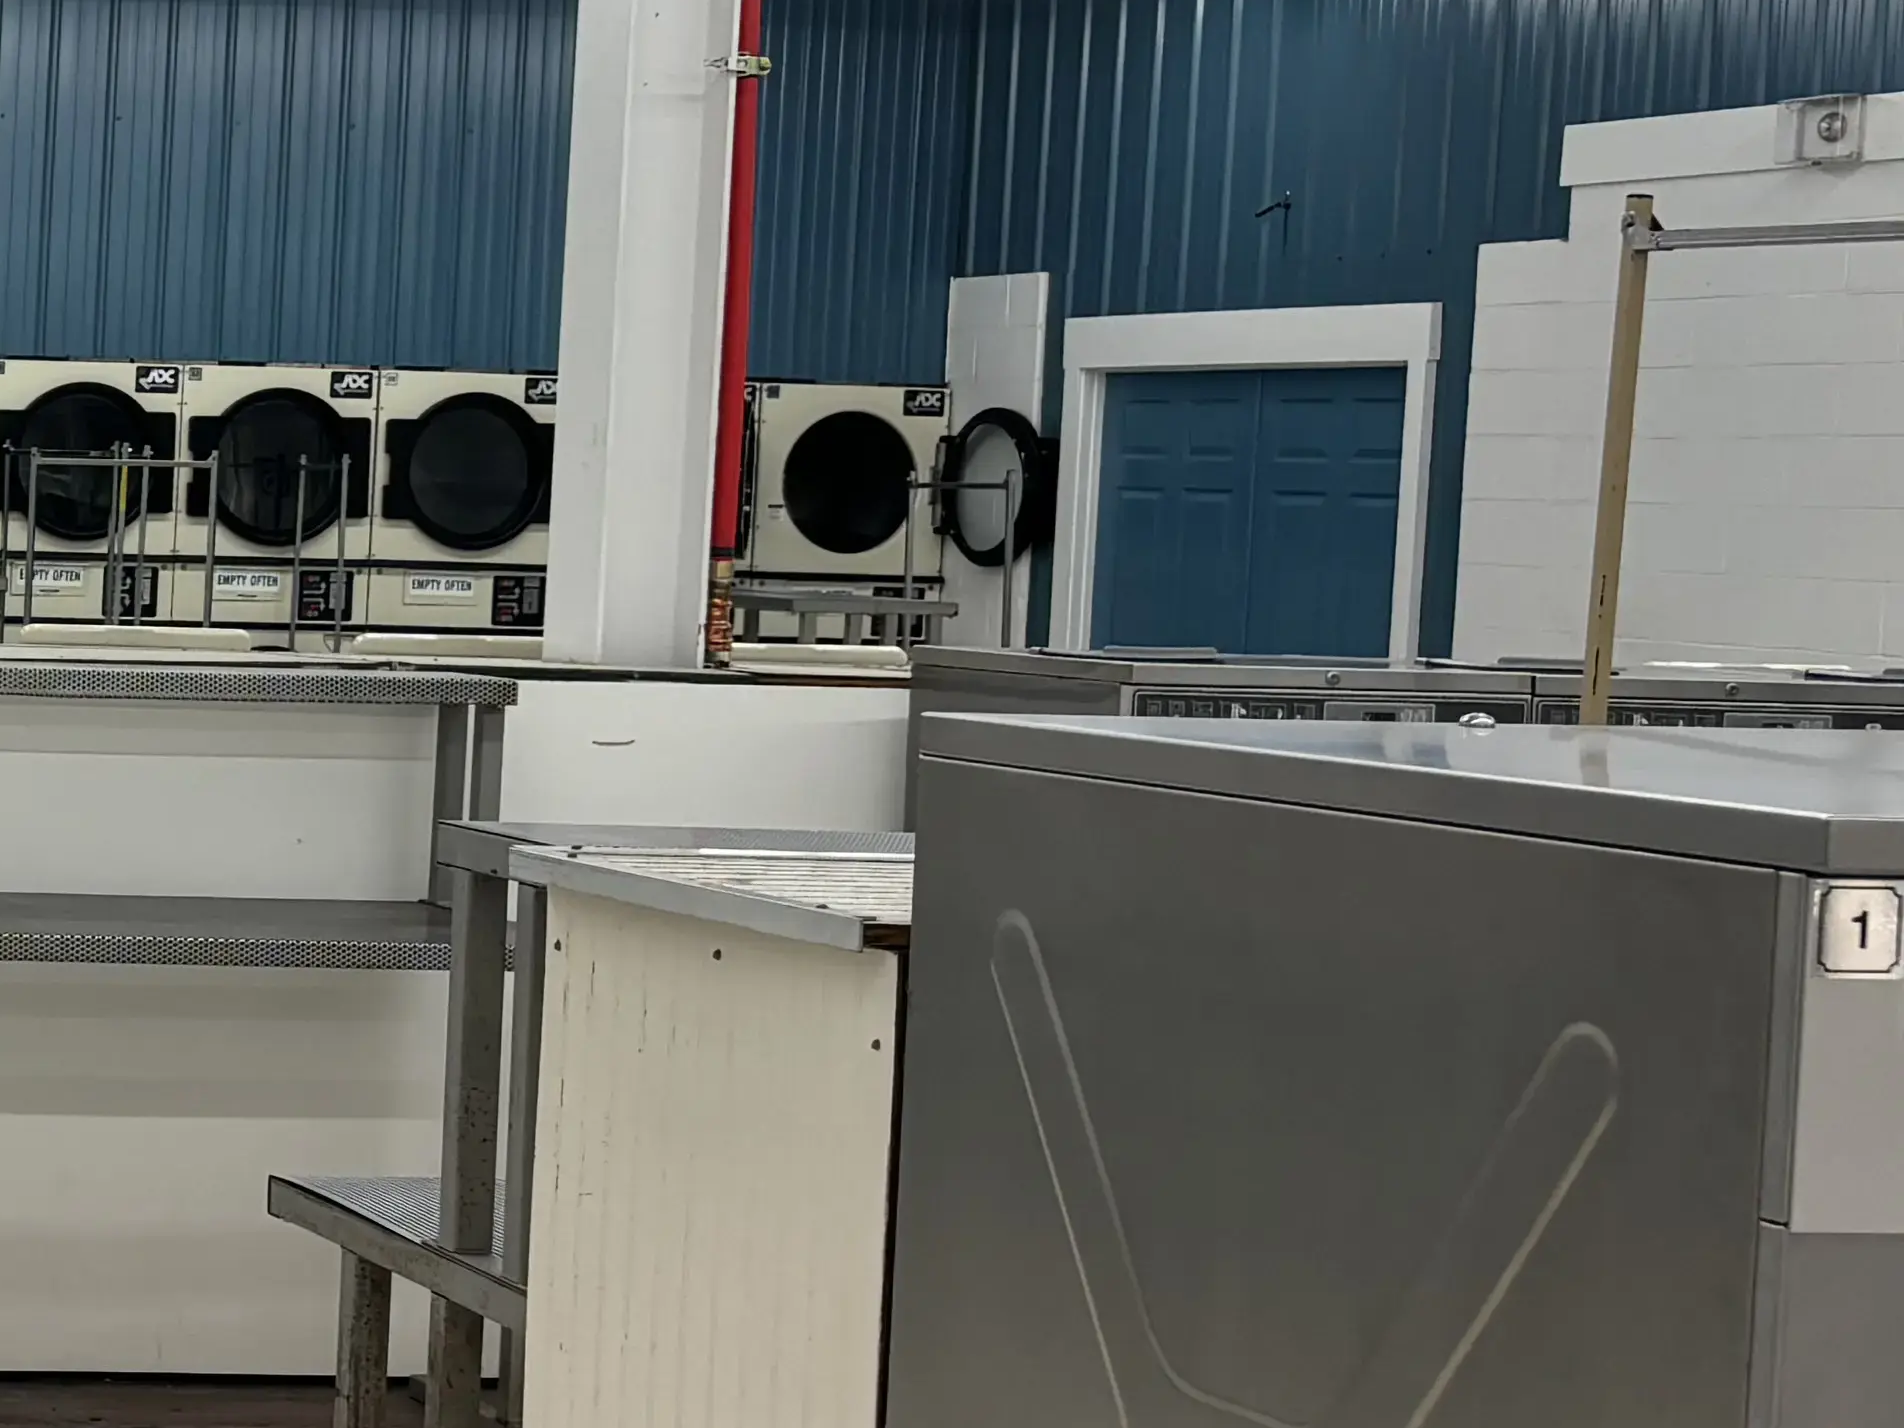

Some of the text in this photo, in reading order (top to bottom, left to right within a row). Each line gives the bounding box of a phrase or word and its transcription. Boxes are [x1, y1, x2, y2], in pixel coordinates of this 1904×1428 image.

[146, 369, 175, 383] ADC
[342, 375, 369, 389] ADC
[536, 380, 557, 393] AD
[20, 569, 81, 581] EPTY OFTEN
[217, 575, 279, 586] EMPTY OFTEN
[412, 579, 472, 591] EMPTY OFTEN
[1851, 910, 1869, 949] 1
